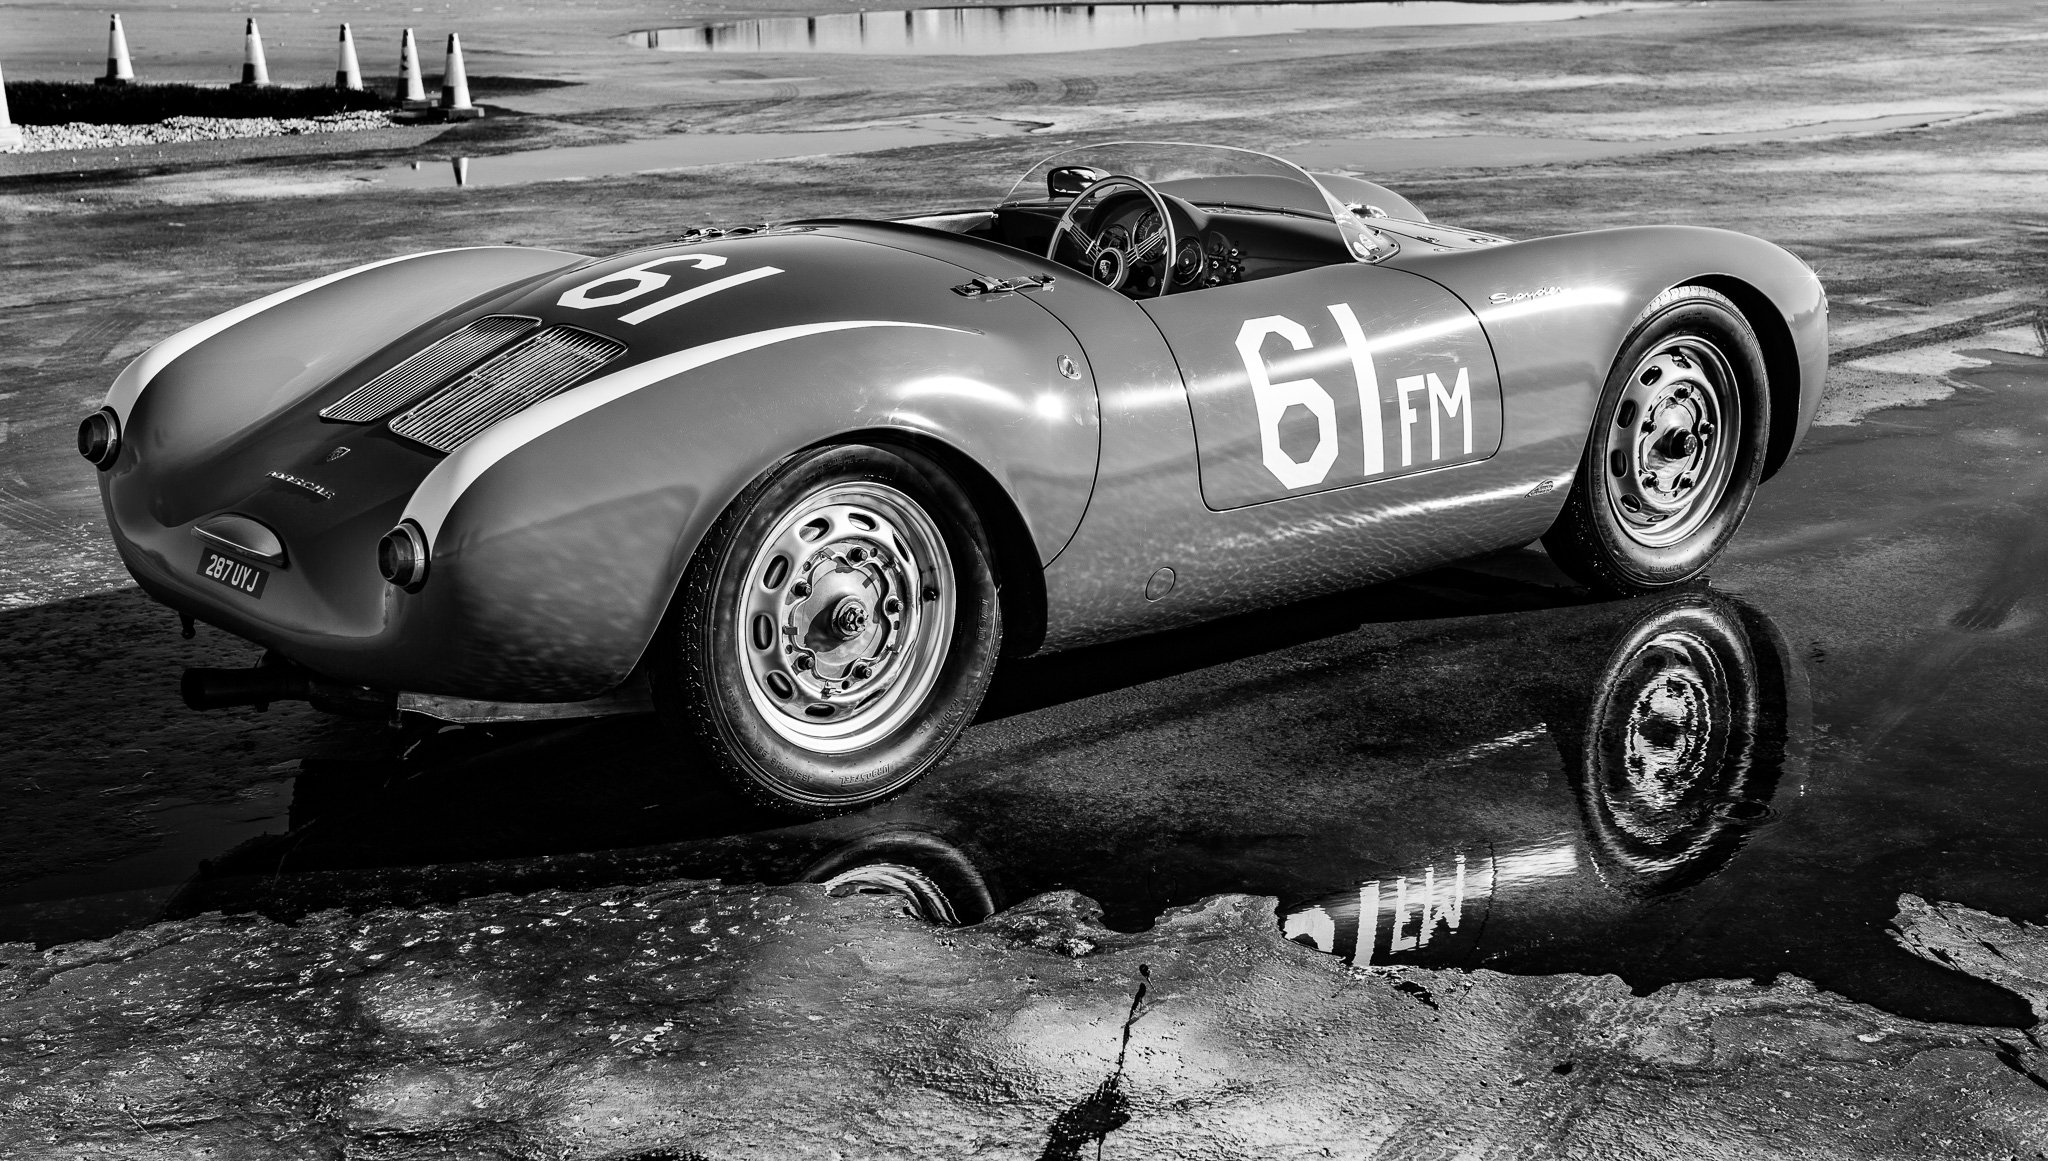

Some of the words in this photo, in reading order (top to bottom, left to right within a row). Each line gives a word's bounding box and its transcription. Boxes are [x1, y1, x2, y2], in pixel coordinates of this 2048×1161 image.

[557, 253, 785, 325] 61
[1489, 286, 1569, 304] Spyder
[1235, 303, 1384, 490] 61
[1396, 367, 1472, 467] FM
[205, 554, 234, 581] 287
[231, 563, 260, 592] UYJ
